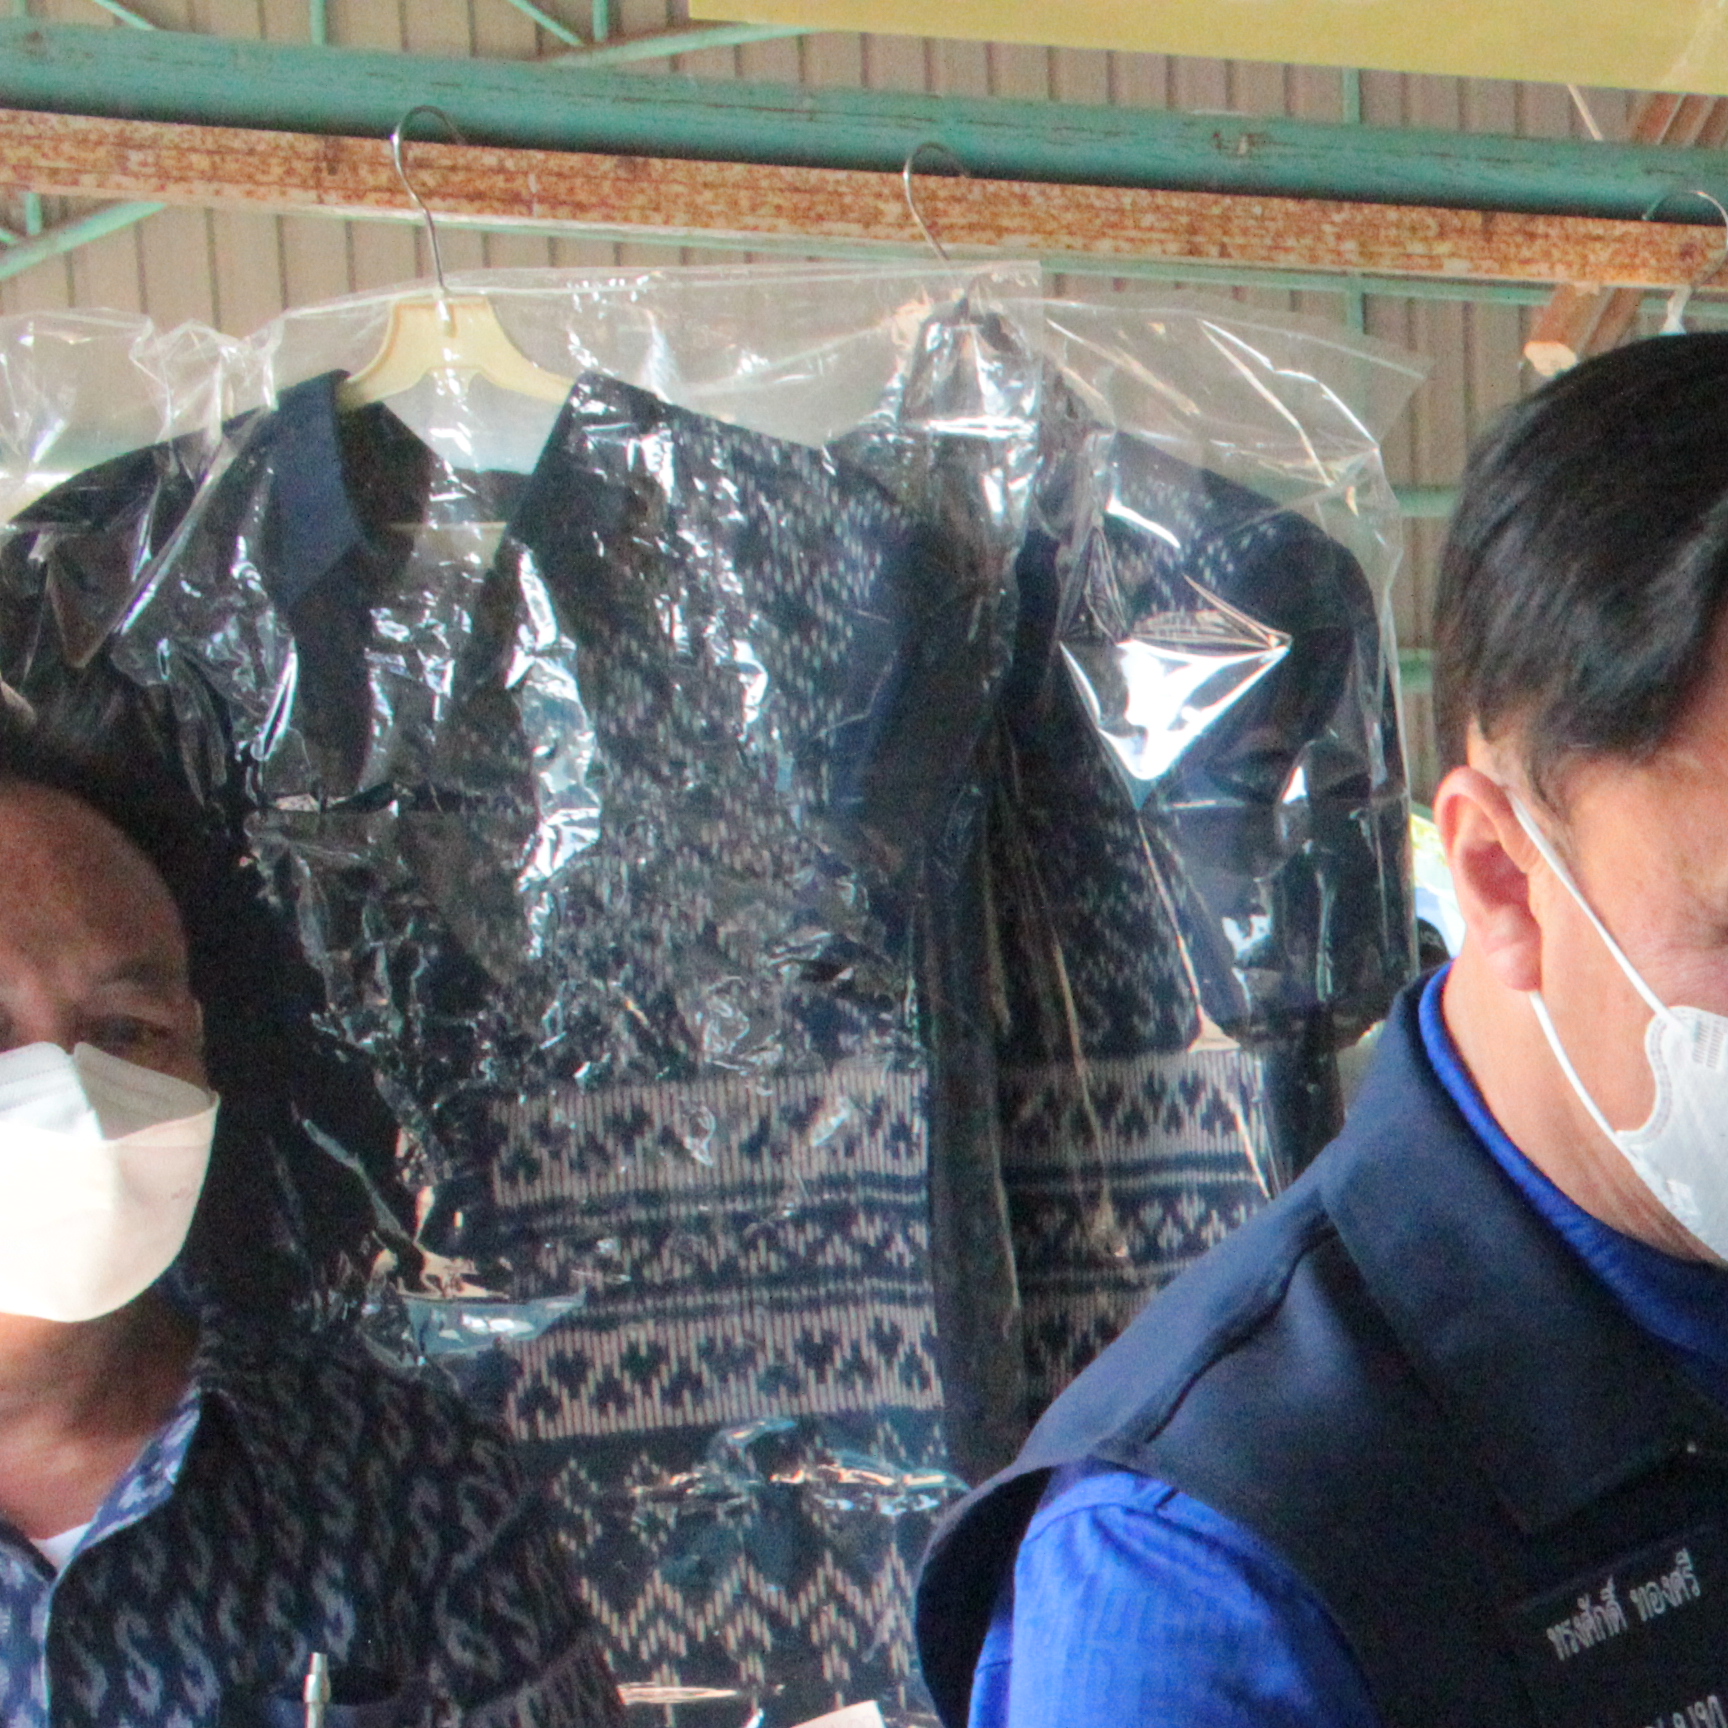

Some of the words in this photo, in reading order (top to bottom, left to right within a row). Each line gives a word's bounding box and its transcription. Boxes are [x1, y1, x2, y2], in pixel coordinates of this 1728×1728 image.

[1546, 1576, 1628, 1661] ทรงศักดิ์
[1629, 1547, 1702, 1623] ทองศรี
